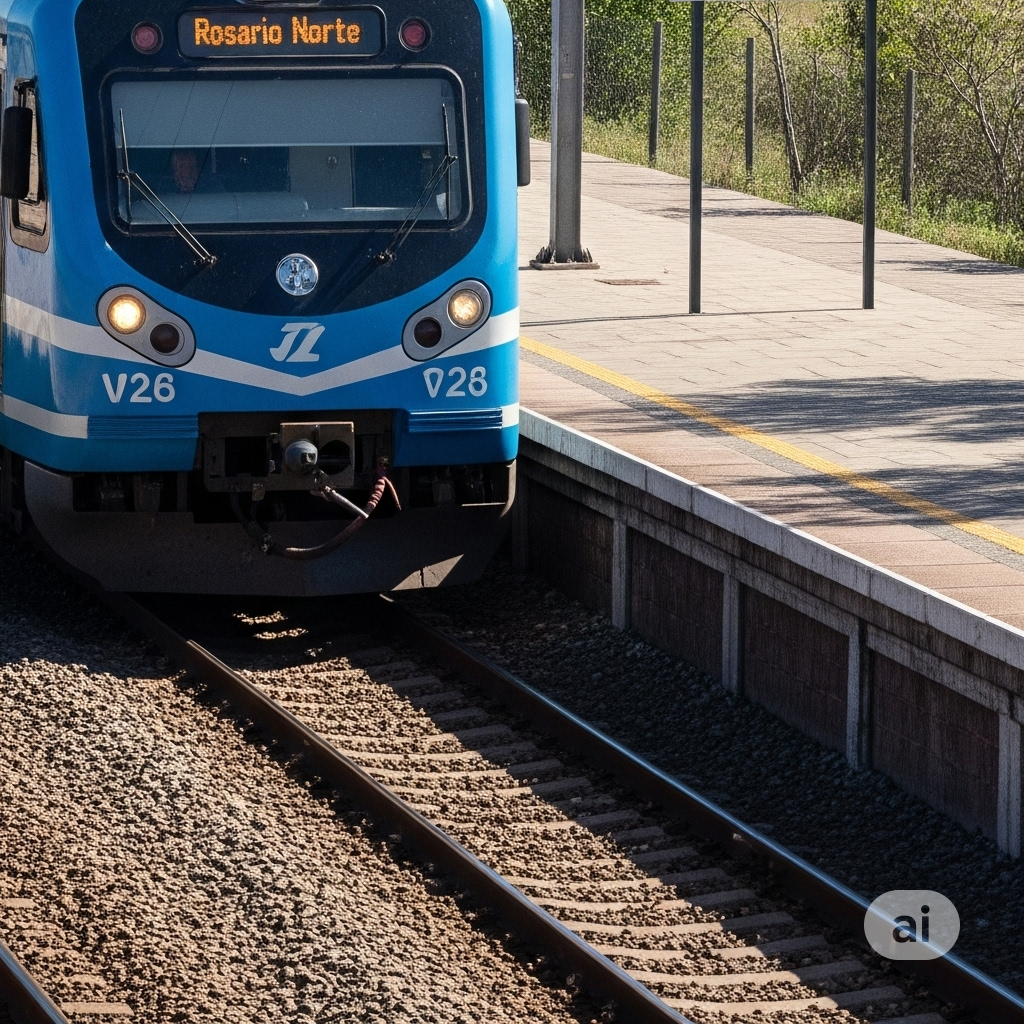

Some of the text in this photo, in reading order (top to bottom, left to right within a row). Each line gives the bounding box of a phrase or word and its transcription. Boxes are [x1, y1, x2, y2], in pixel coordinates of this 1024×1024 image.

[194, 16, 361, 46] Rosario Norte
[102, 372, 176, 404] V26
